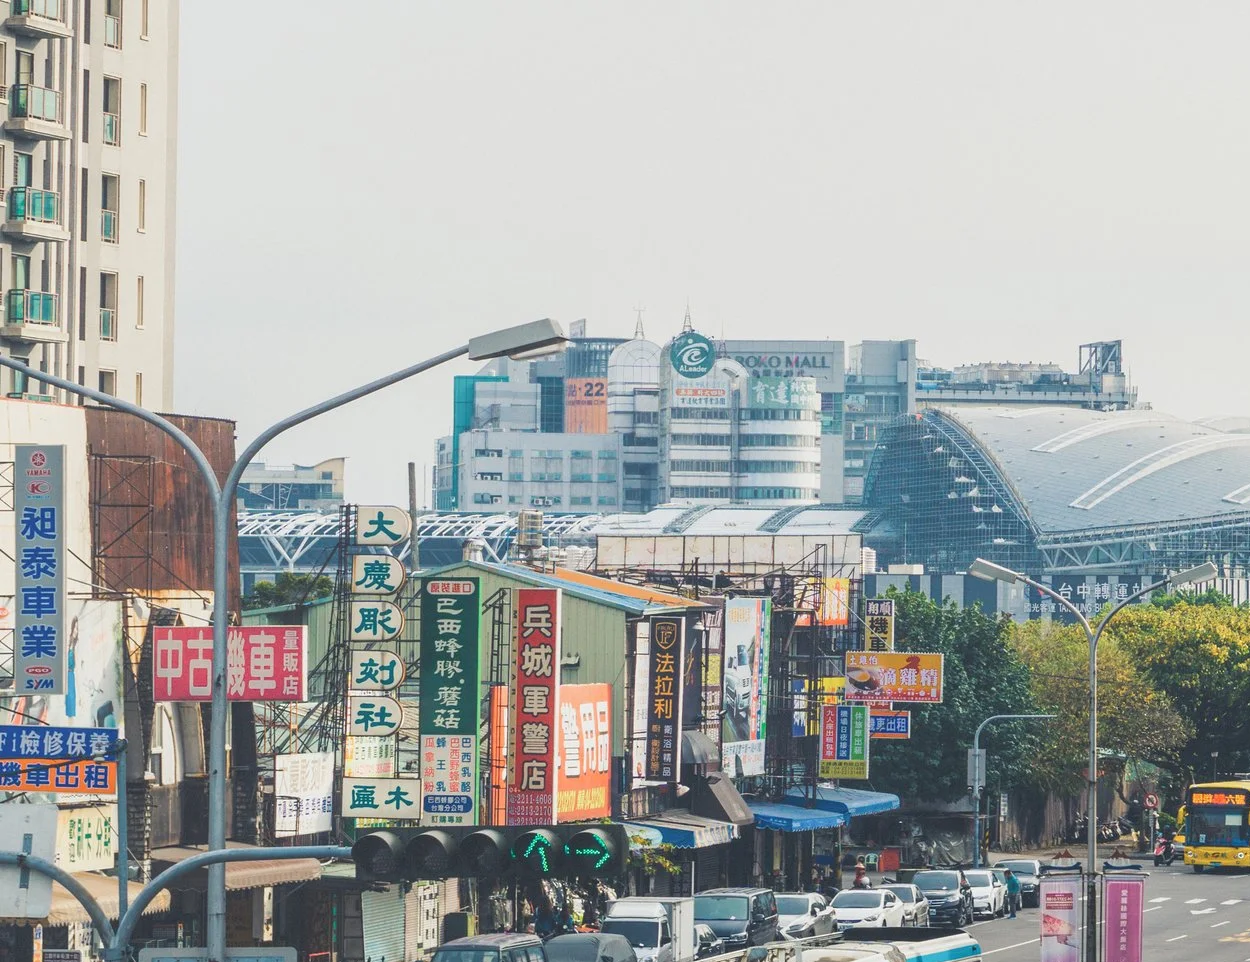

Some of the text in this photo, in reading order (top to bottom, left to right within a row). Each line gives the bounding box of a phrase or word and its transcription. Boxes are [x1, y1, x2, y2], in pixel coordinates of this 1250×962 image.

[785, 355, 830, 368] MALL
[26, 469, 51, 477] YAMAHA
[868, 601, 891, 615] 翔順
[26, 678, 54, 691] SYM
[283, 630, 299, 697] 量販店
[653, 653, 675, 719] 法拉利
[879, 667, 938, 687] 滴雞精
[521, 605, 553, 791] 兵城軍警店
[0, 761, 109, 790] 機車出租
[423, 738, 435, 793] 瓜拿納粉
[436, 737, 447, 793] 蜂王乳
[448, 737, 460, 793] 巴西野蜂蜜
[461, 737, 472, 793] 巴西乳酪
